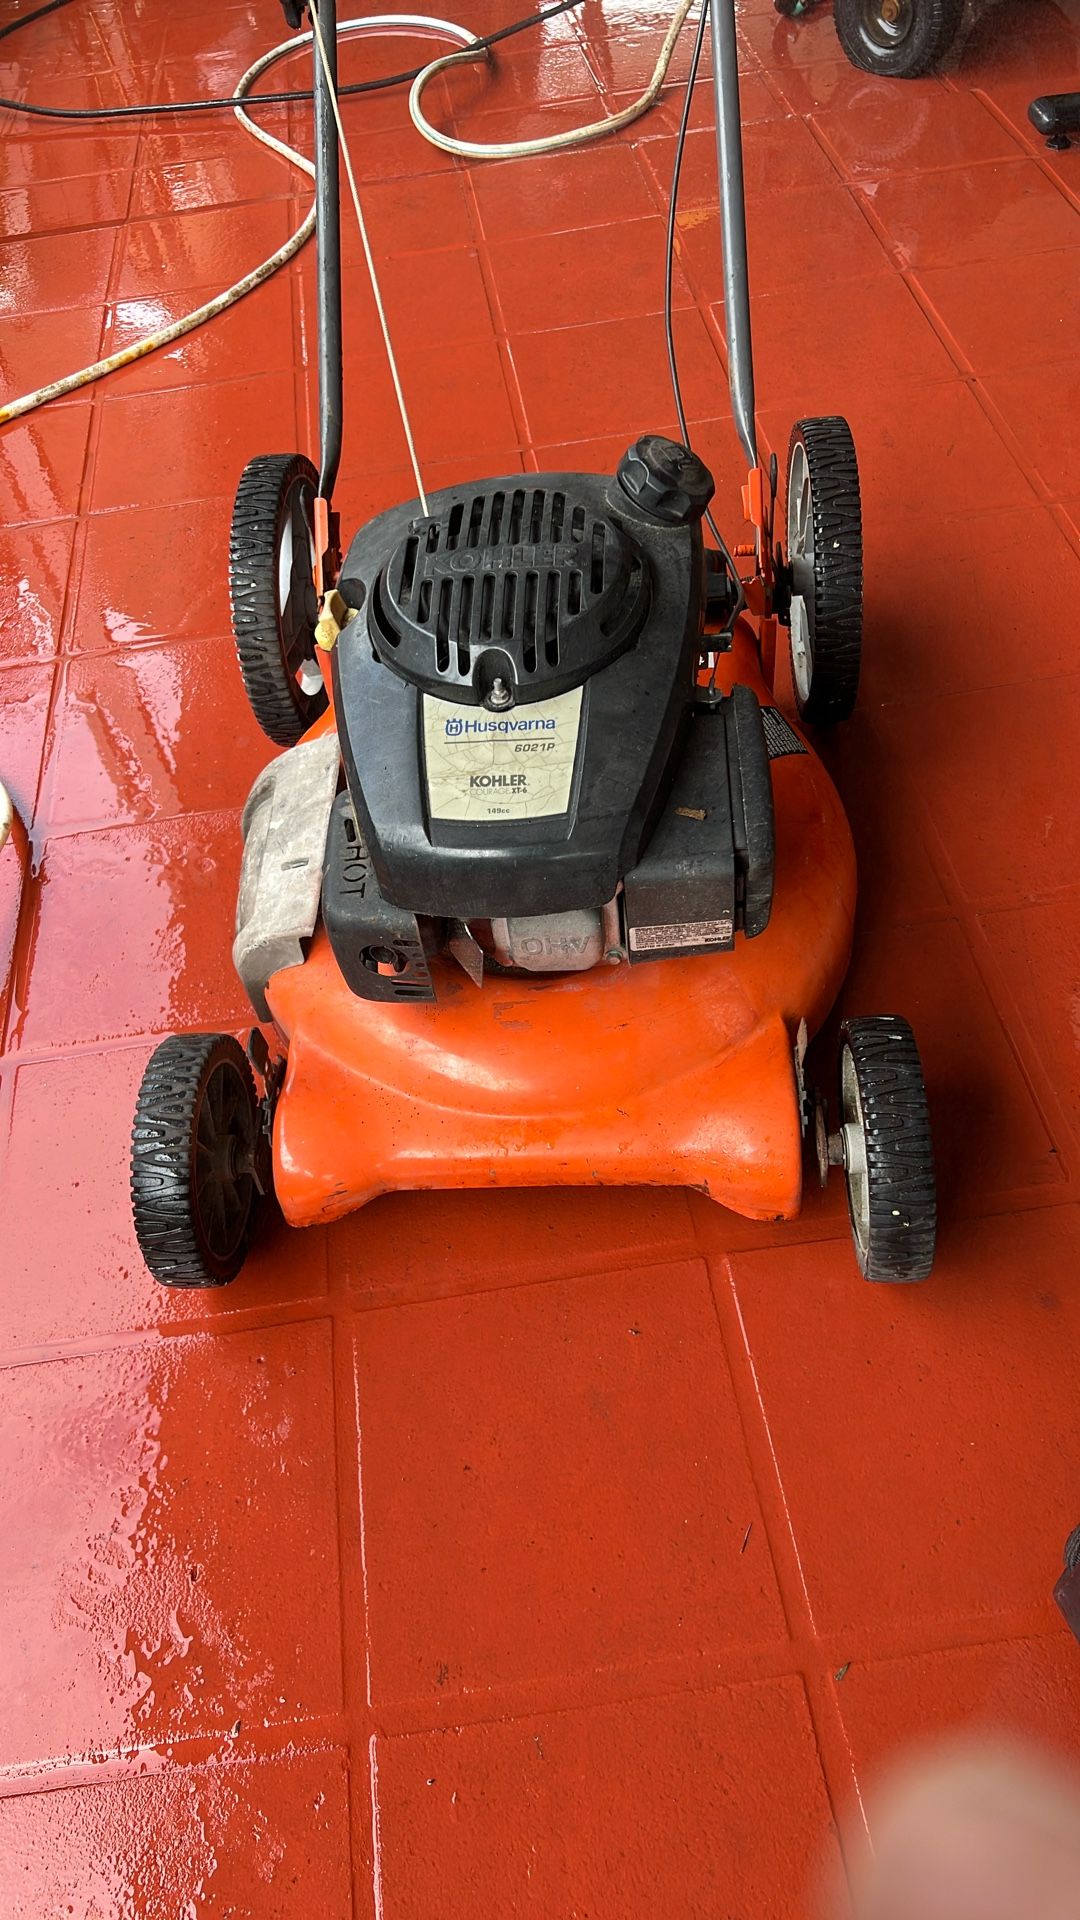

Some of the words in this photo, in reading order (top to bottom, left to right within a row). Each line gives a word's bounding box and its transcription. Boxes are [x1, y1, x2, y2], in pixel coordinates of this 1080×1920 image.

[424, 545, 578, 577] KOHLER
[465, 719, 556, 734] Husqvarna
[514, 743, 555, 752] 6021P
[470, 774, 527, 787] KOHLER
[340, 846, 367, 898] HOT
[521, 936, 591, 955] OHV
